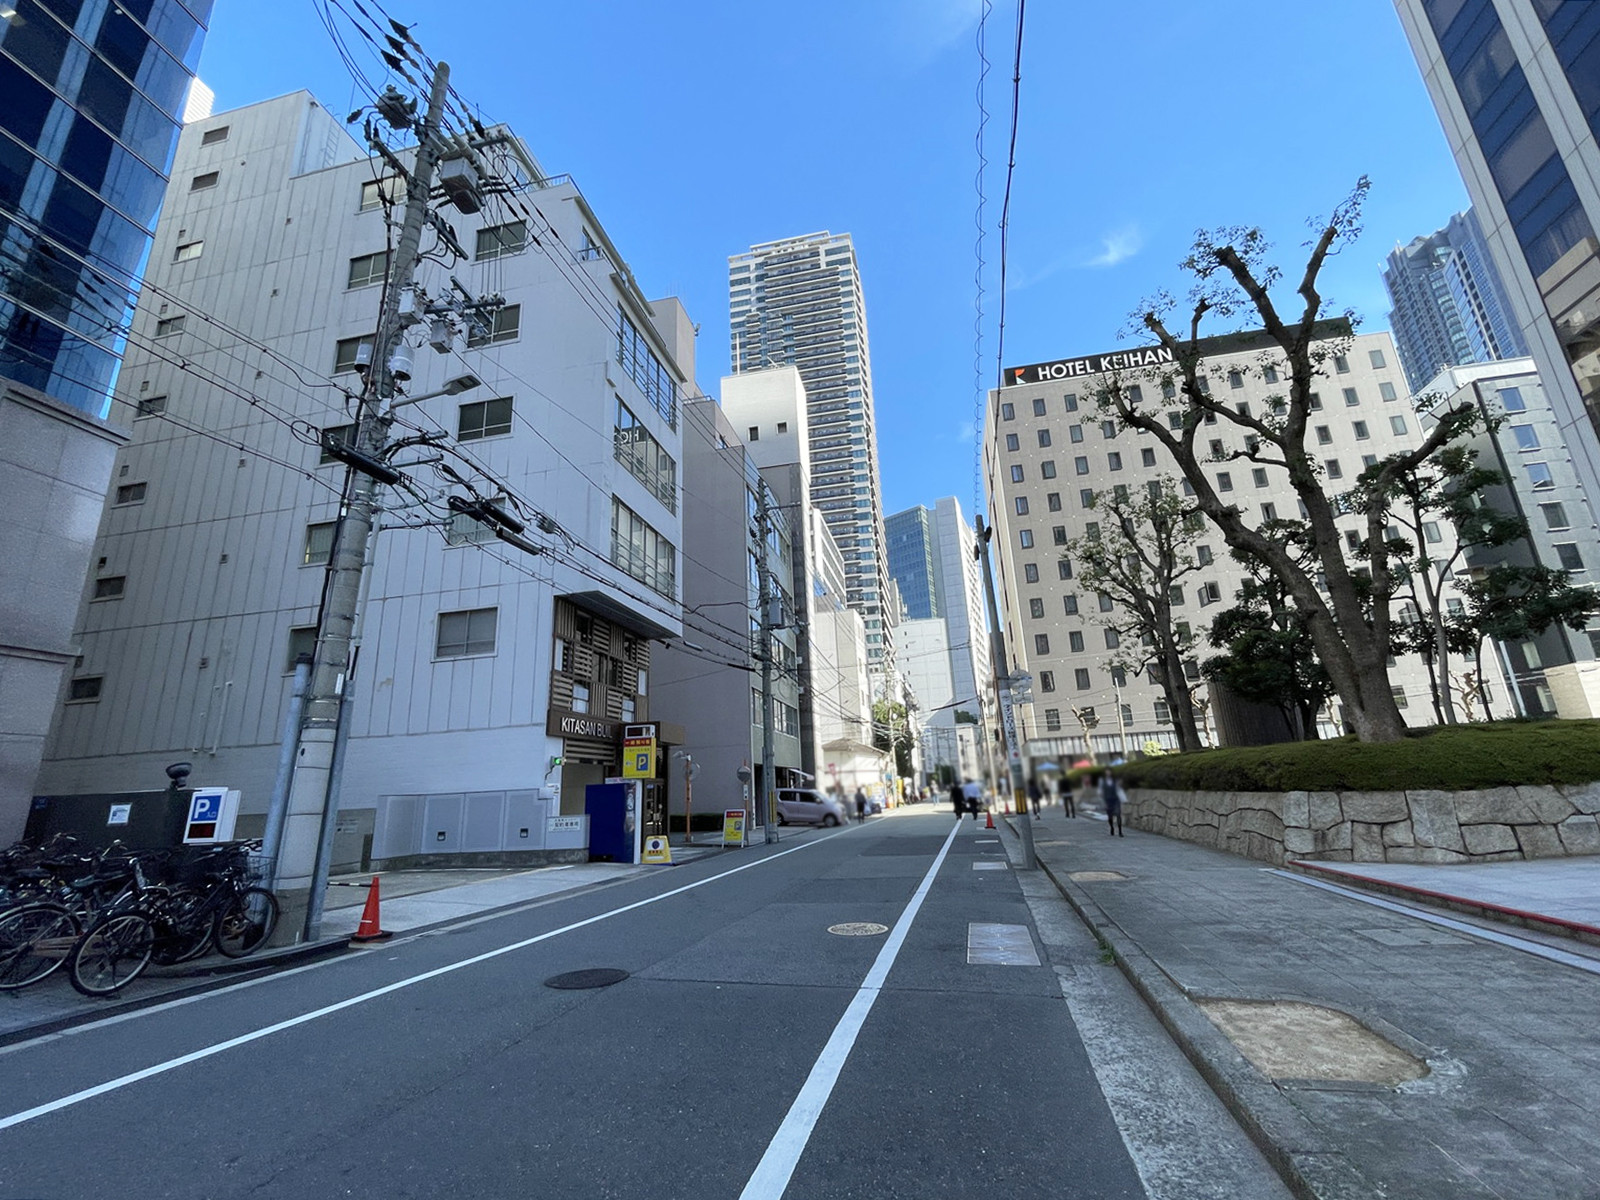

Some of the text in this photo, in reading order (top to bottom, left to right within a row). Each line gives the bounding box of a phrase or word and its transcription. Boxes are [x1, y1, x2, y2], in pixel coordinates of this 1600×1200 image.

[1037, 347, 1173, 380] HOTEL KEIHAN
[561, 717, 596, 736] KITASAN
[637, 756, 647, 770] P
[194, 799, 211, 819] P
